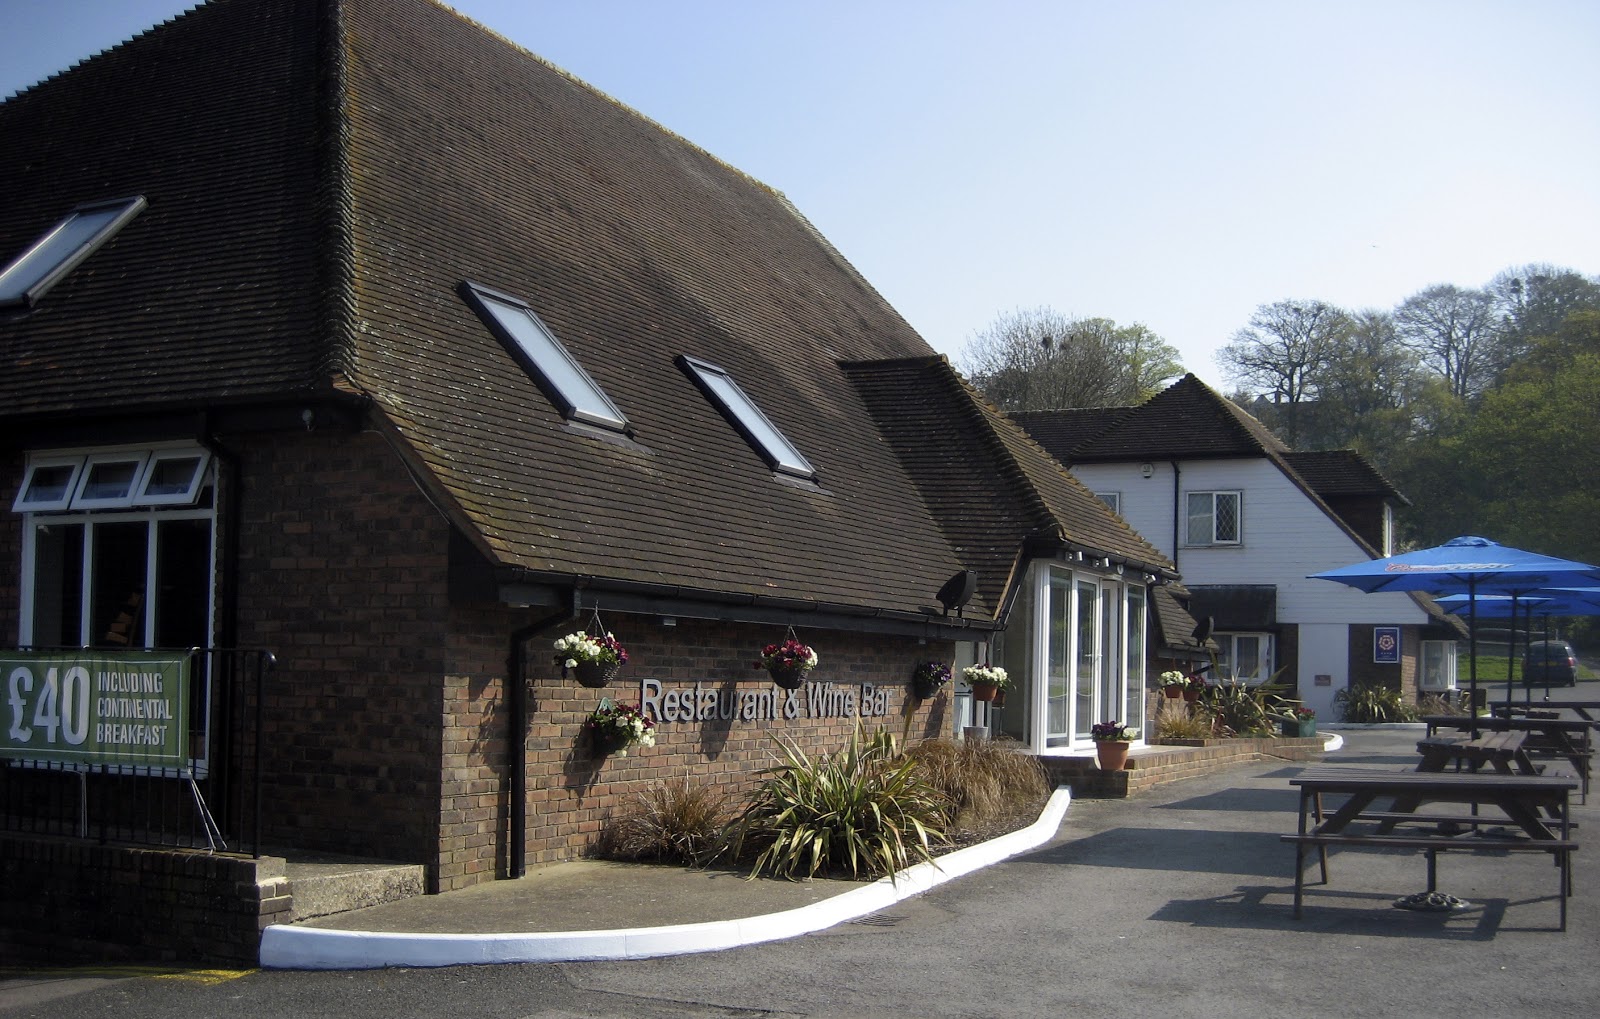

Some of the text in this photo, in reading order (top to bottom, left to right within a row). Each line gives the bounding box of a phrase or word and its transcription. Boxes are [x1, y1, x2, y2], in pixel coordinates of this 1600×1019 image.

[98, 671, 163, 693] INCLUDING
[8, 666, 91, 745] £40
[97, 698, 172, 720] CONTINENTAL
[641, 679, 893, 721] Restaurant & Wine Bar
[96, 723, 168, 746] BREAKFAST
